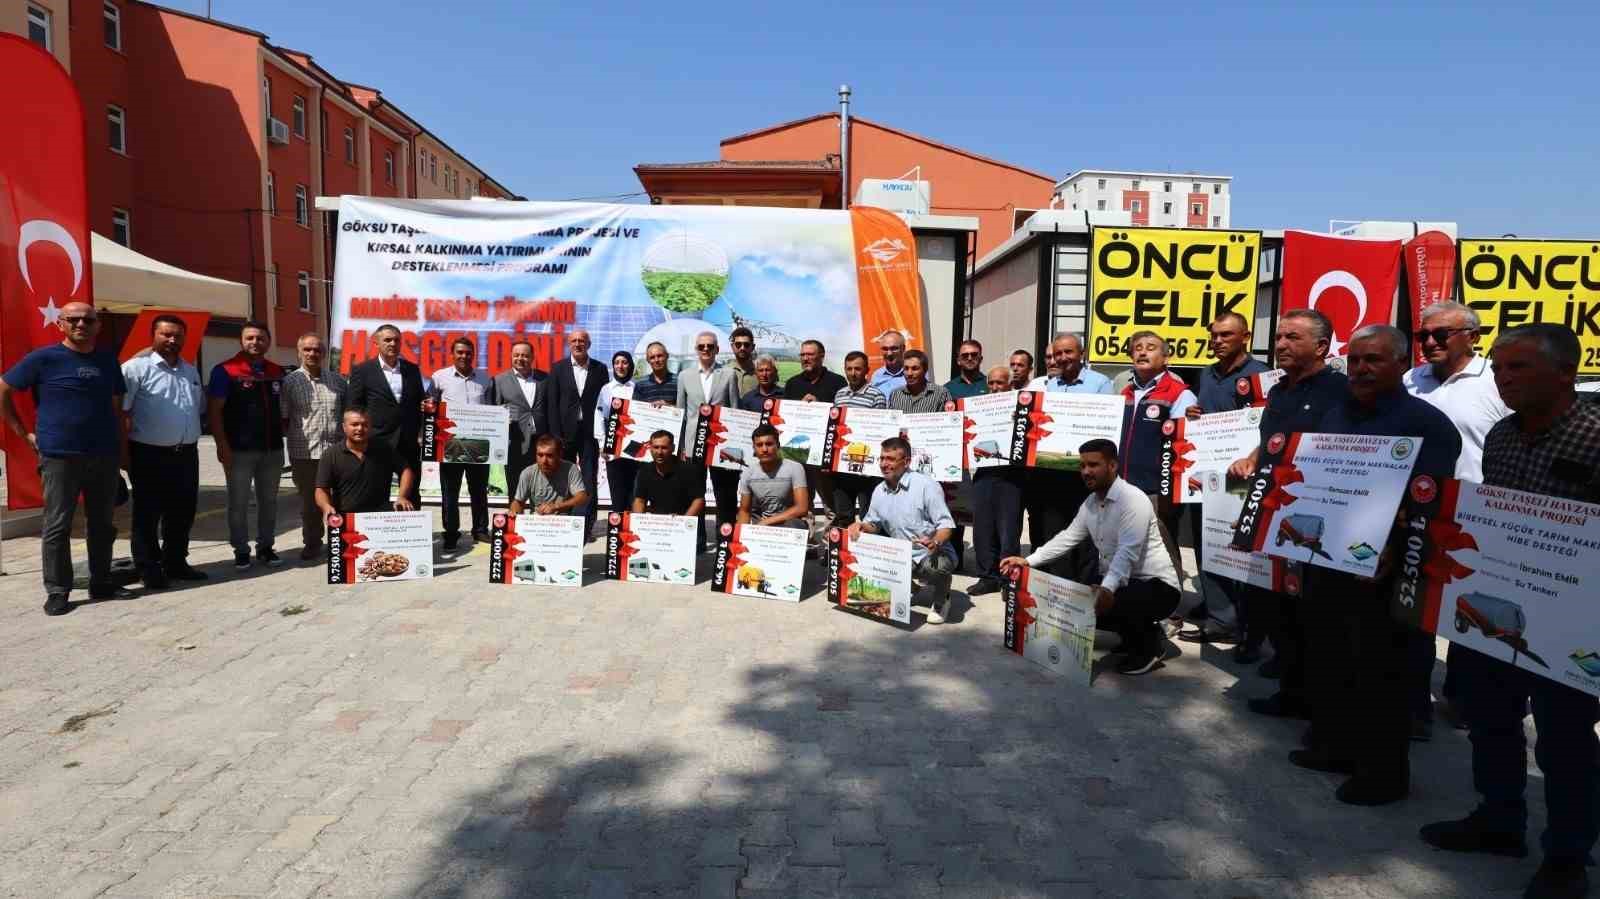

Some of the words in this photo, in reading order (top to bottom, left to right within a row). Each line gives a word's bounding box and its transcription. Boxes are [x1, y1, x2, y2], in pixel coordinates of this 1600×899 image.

[342, 221, 388, 233] GÖKSU
[391, 223, 427, 237] TAŞ
[567, 226, 620, 238] PRJESİ
[624, 228, 640, 238] VE
[367, 242, 411, 254] KIRSAL
[415, 244, 482, 256] KALKINMA
[1098, 232, 1254, 282] ÖNCÜ
[1095, 283, 1249, 334] ÇELİK
[1013, 417, 1027, 461] 798.493
[1160, 452, 1171, 496] 60.000
[1240, 479, 1267, 535] 52.500
[1476, 486, 1507, 500] GÖKSU
[1511, 491, 1550, 507] TAŞELİ
[1457, 511, 1499, 528] BİREYSEL
[1501, 520, 1535, 536] KÜÇÜK
[1537, 528, 1571, 543] TARIM
[1484, 499, 1538, 517] KALKINMA
[1539, 509, 1588, 527] PROJESİ
[492, 544, 502, 579] 272.000
[608, 539, 618, 576] 272.000
[1506, 535, 1530, 546] HİBE
[1532, 541, 1578, 558] DESTEĞİ
[713, 555, 726, 585] 66.500
[1400, 535, 1424, 609] 52.500
[1519, 564, 1554, 578] İbrahim
[1554, 572, 1580, 586] EMİR
[1514, 579, 1526, 588] Su
[1527, 582, 1560, 598] Tankeri
